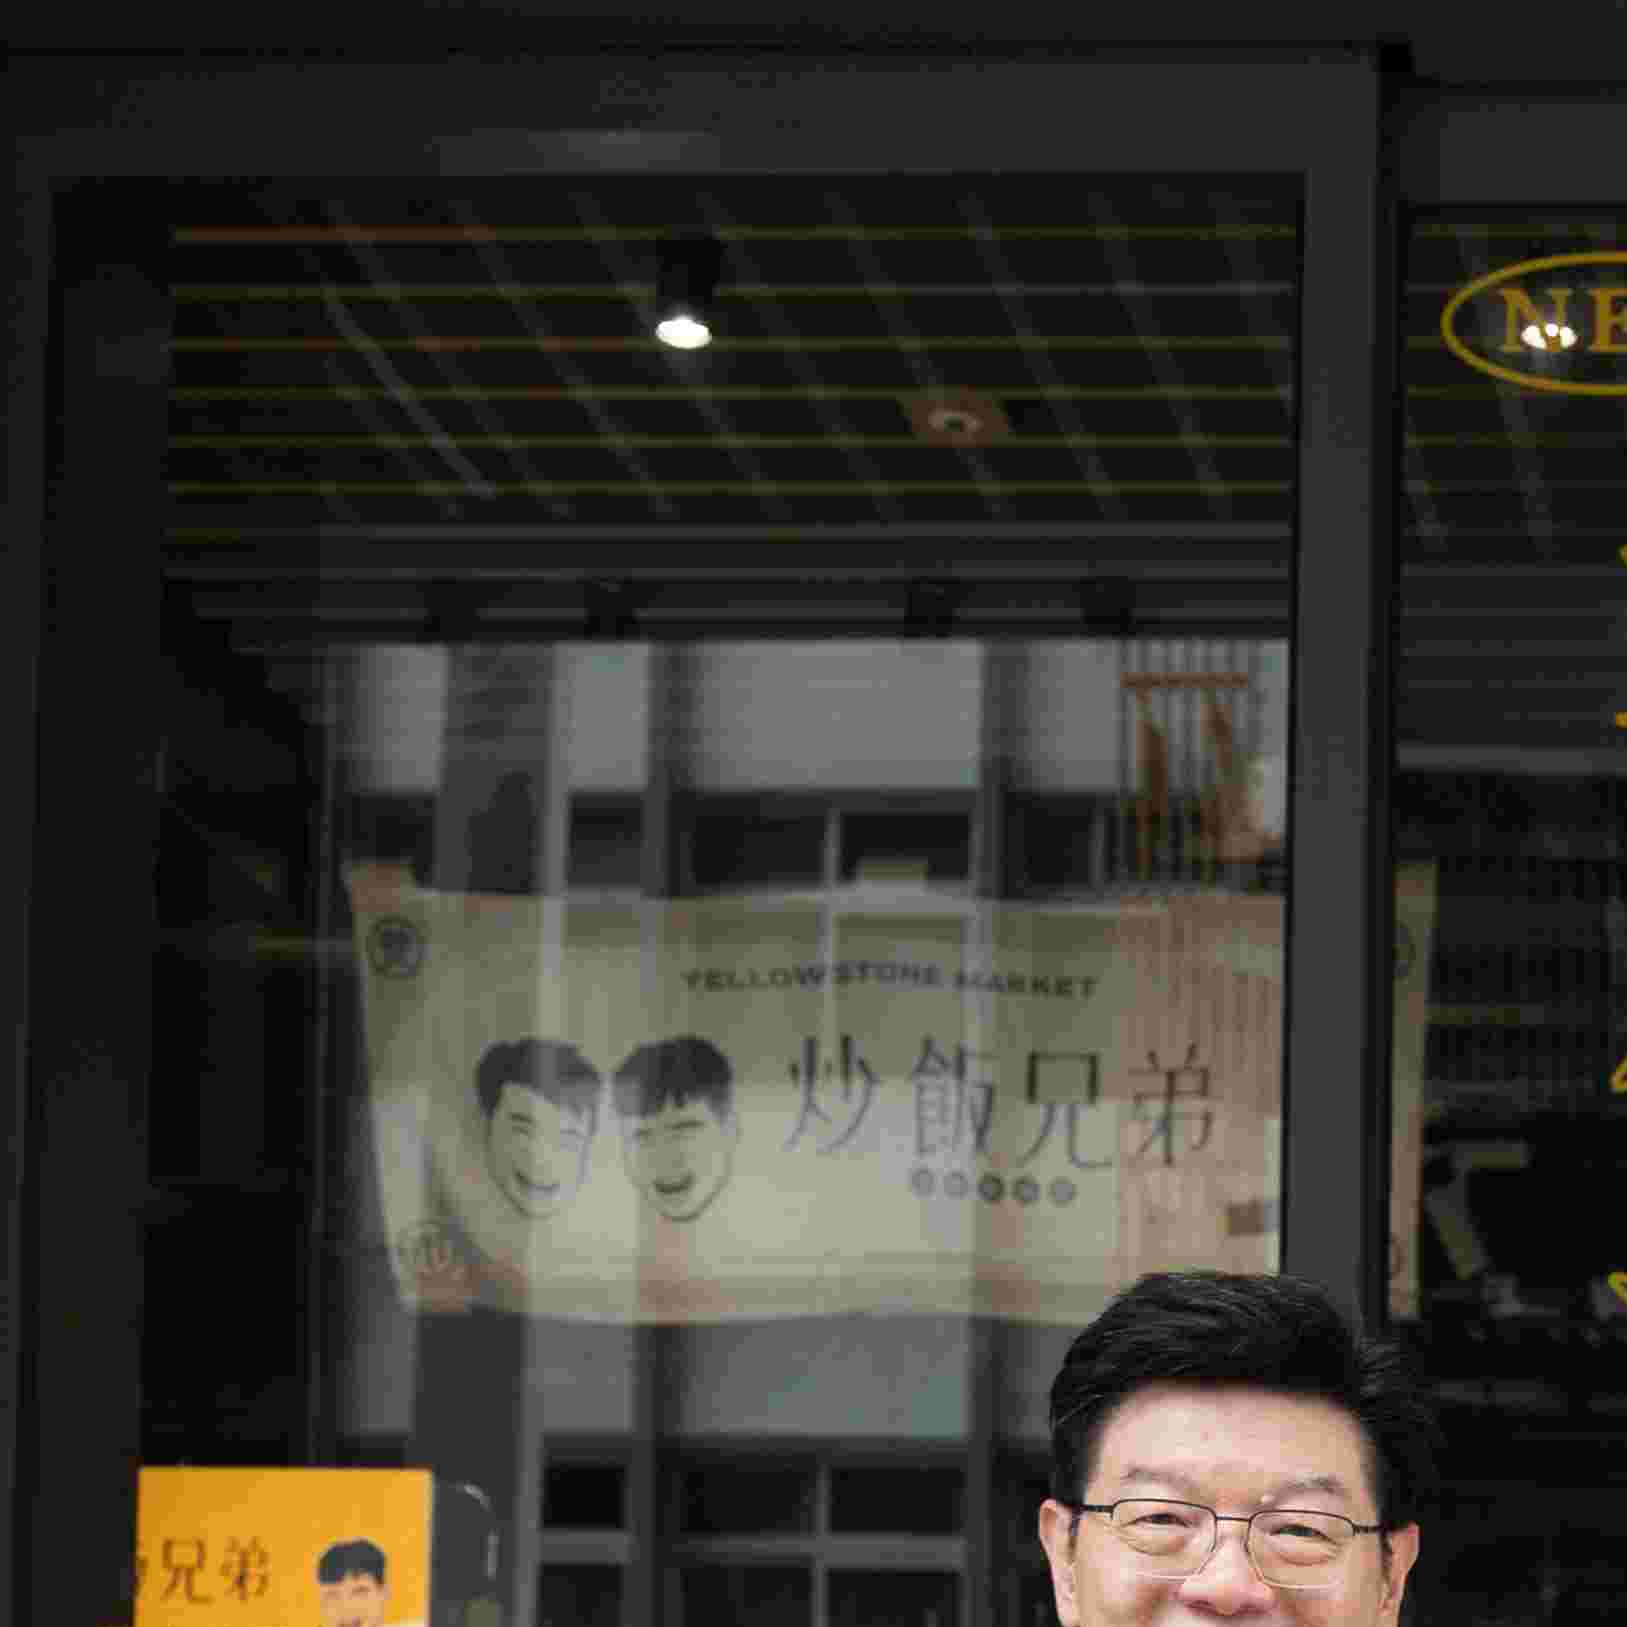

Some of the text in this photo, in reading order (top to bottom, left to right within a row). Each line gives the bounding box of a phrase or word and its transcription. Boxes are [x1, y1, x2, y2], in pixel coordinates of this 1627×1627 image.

[681, 960, 1099, 999] YELLOWSTONE MARKET
[783, 1034, 1213, 1168] 炒飯兄弟
[137, 1536, 271, 1606] 兄弟
